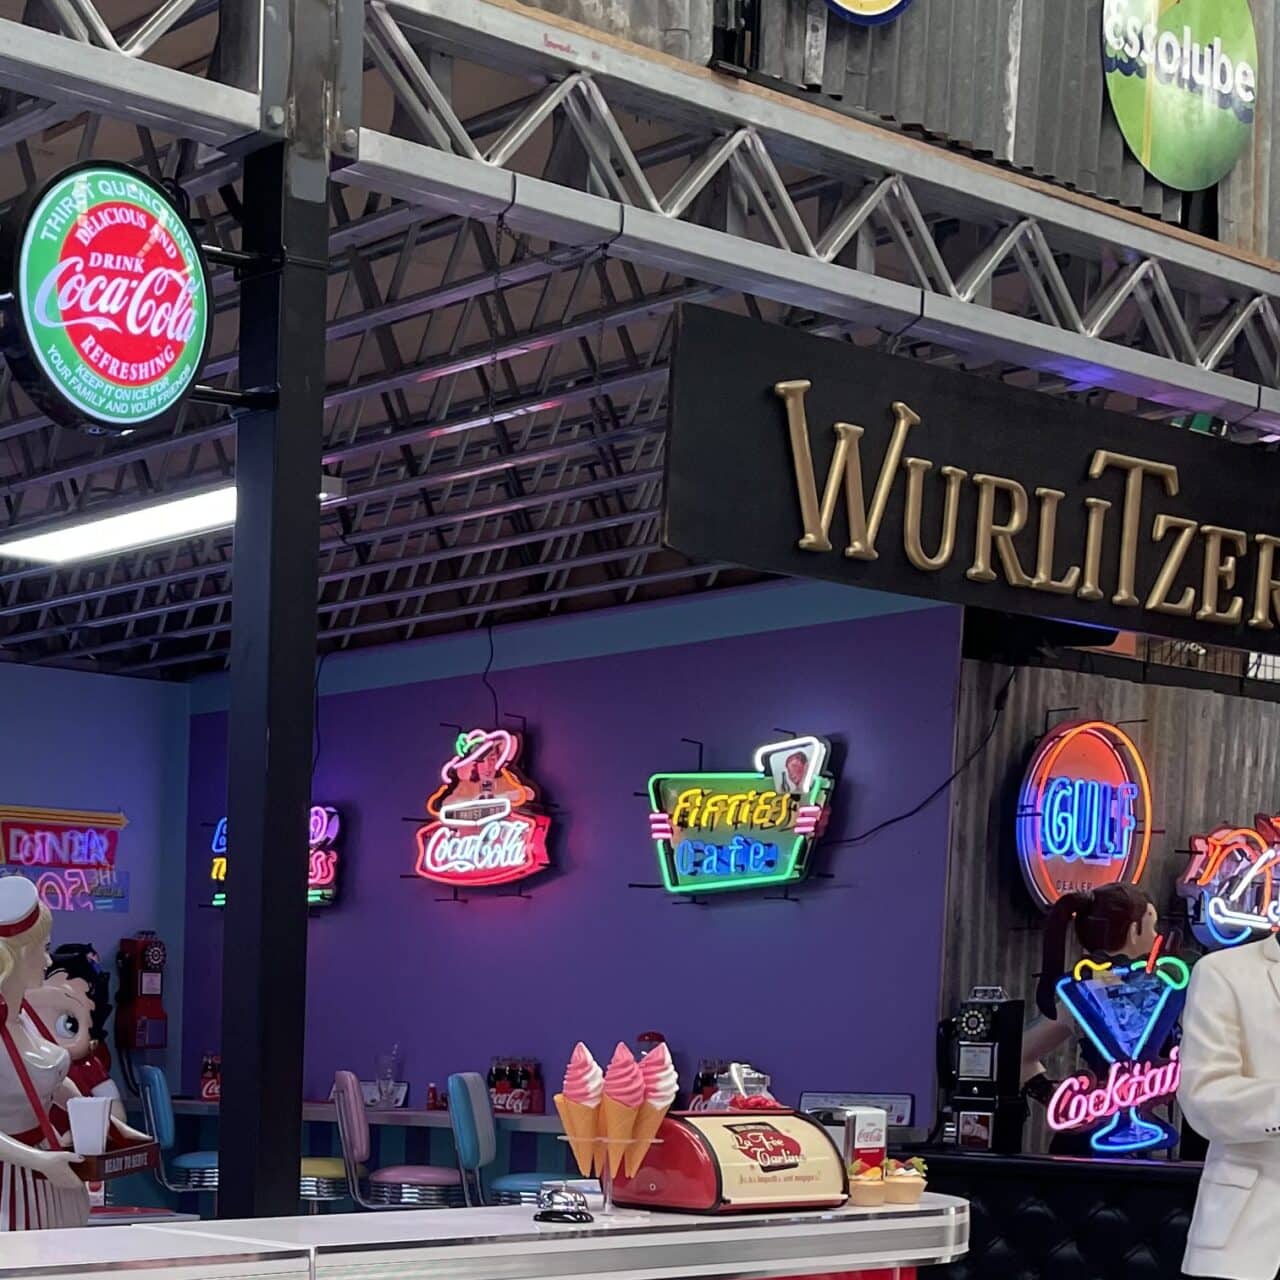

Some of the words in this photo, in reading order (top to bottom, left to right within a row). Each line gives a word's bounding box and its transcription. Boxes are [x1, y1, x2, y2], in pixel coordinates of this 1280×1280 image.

[1105, 14, 1256, 103] essolube
[74, 207, 147, 248] DELICIOUS
[149, 223, 177, 260] AND
[88, 251, 144, 274] DRINK
[34, 256, 197, 343] Coca-Cola
[47, 343, 72, 380] YOUR
[68, 375, 106, 408] FAMILY
[105, 401, 129, 414] AND
[130, 398, 157, 414] YOUR
[75, 362, 104, 389] KEEP
[103, 385, 115, 397] IT
[114, 388, 133, 400] ON
[133, 388, 150, 400] ICE
[150, 375, 170, 397] FOR
[80, 334, 176, 381] REFRESHING
[1043, 777, 1138, 858] GULF
[8, 827, 110, 865] DINER
